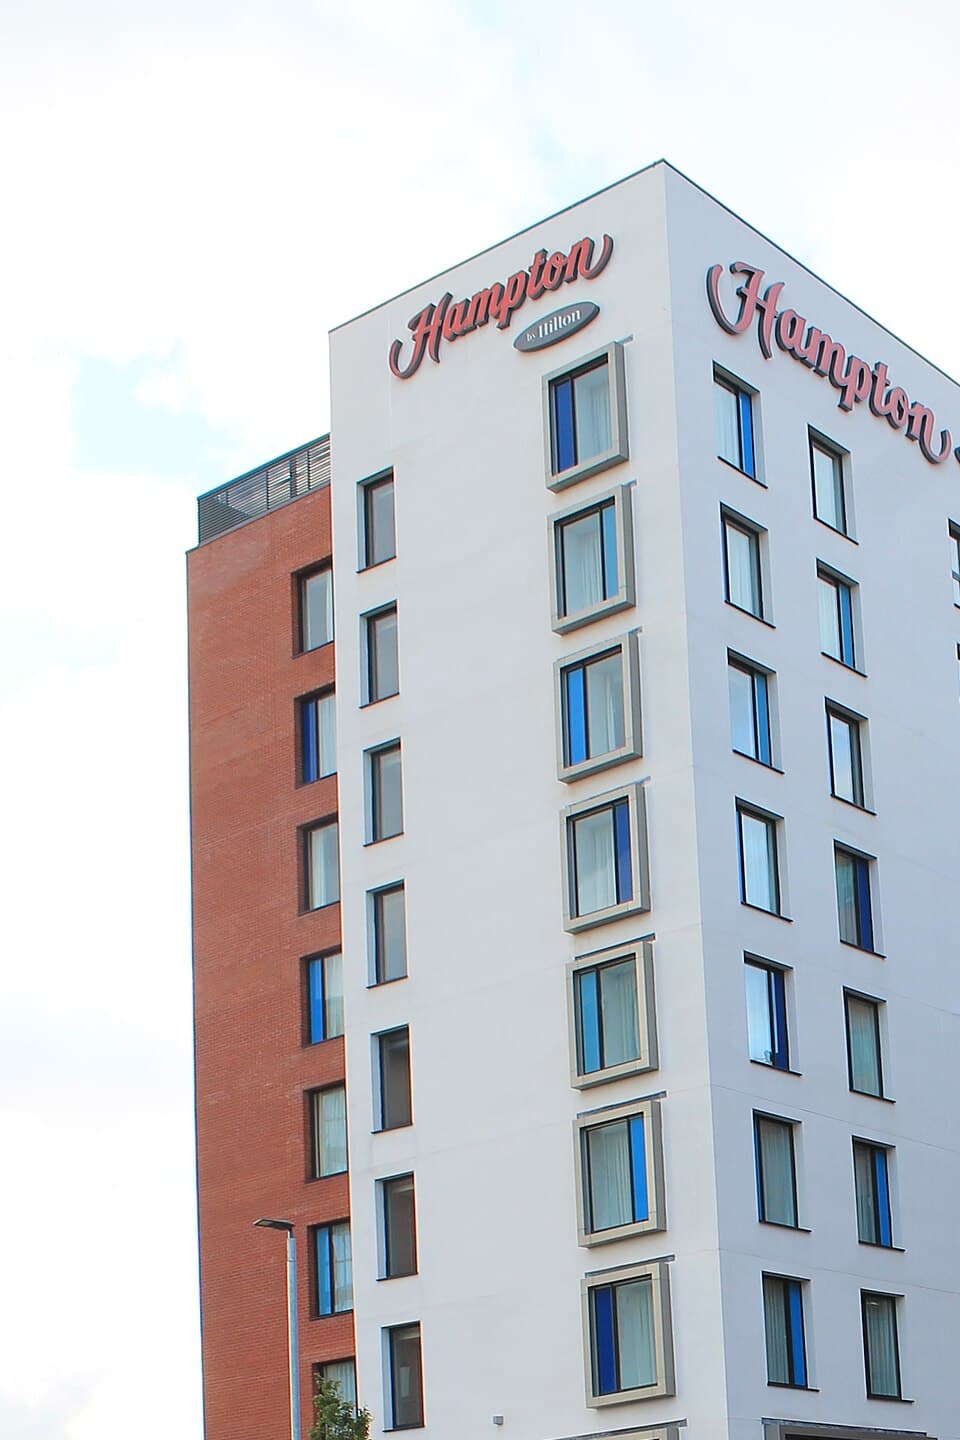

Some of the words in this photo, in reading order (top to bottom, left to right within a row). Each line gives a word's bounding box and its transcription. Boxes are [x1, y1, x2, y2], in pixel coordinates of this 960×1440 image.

[389, 234, 613, 379] Hampton
[526, 333, 536, 342] by
[538, 310, 580, 338] Hilton
[706, 262, 951, 464] Hampton
